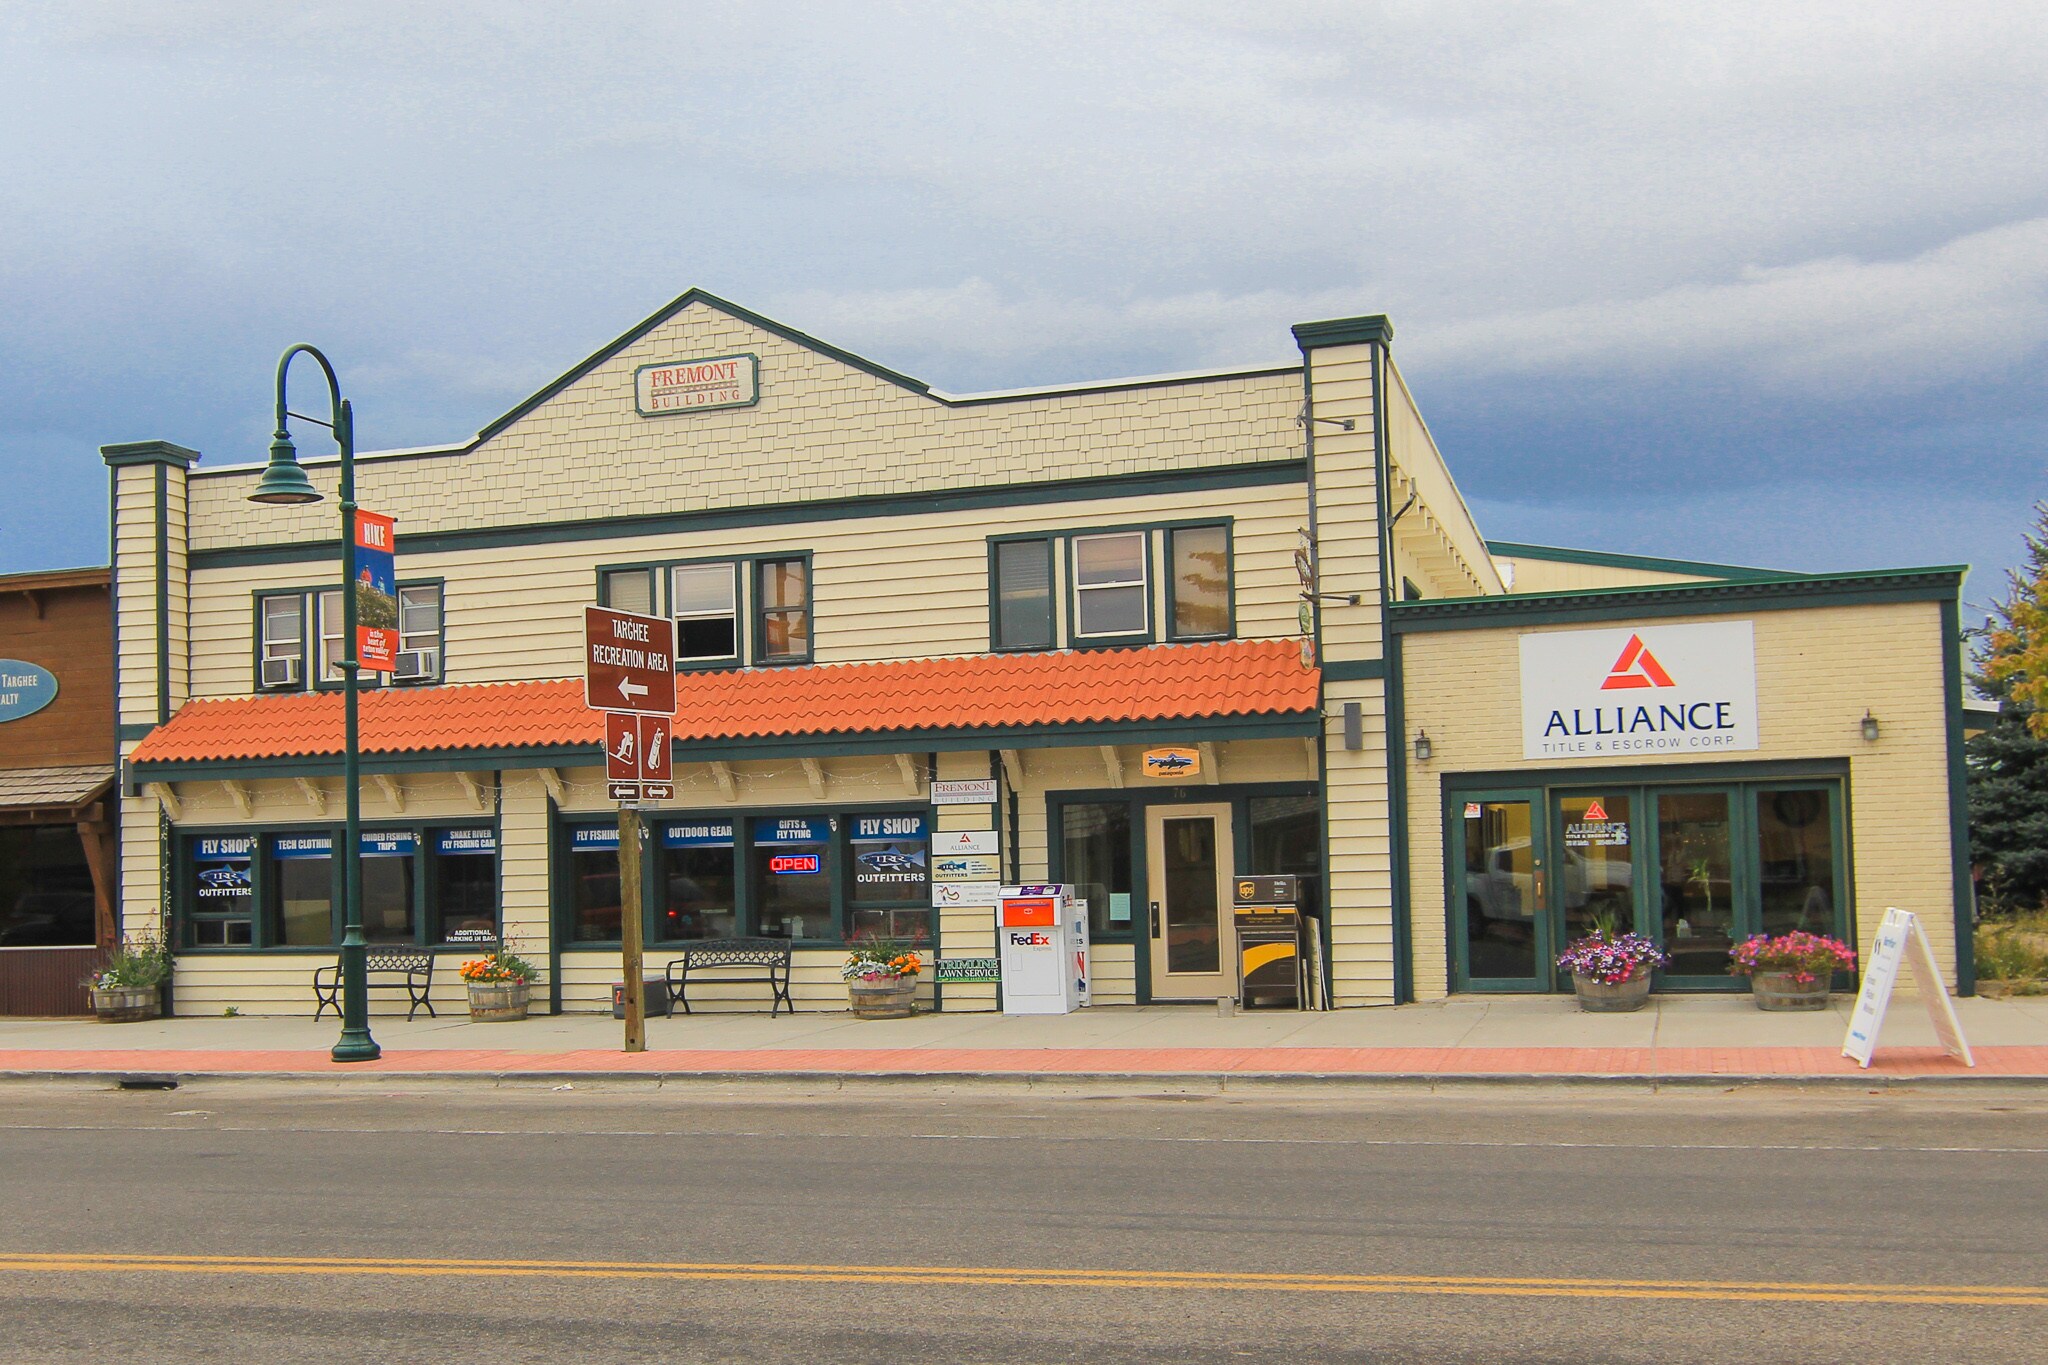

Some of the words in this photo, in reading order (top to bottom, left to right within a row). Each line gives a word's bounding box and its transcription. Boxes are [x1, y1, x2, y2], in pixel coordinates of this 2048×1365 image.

[651, 362, 738, 387] FREMONT
[652, 389, 740, 409] BUILDING
[363, 522, 386, 546] HIKE
[612, 619, 650, 642] TARGHEE
[593, 644, 645, 669] RECREATION
[647, 652, 668, 672] AREA
[1, 674, 38, 687] TARGHEE
[0, 693, 19, 705] ALTY
[1543, 702, 1735, 737] ALLIANCE
[1543, 742, 1586, 752] TITLE
[1595, 741, 1602, 750] &
[1612, 738, 1681, 750] ESCROW
[1690, 735, 1736, 747] CORP.
[935, 782, 993, 792] FREMONT
[1173, 787, 1186, 799] 76
[779, 820, 800, 830] GIFTS
[801, 820, 807, 829] &
[860, 819, 882, 835] FLY
[883, 818, 920, 834] SHOP
[1566, 823, 1626, 834] ALLIANCE
[361, 833, 385, 842] GUIDED
[387, 832, 412, 841] FISHING
[450, 830, 471, 839] SNAKE
[472, 830, 492, 838] RIVER
[576, 830, 589, 841] FLY
[589, 829, 620, 841] FISHING
[668, 827, 709, 838] OUTDOOR
[710, 826, 733, 837] GEAR
[776, 830, 790, 840] FLY
[789, 829, 812, 839] TYING
[202, 839, 219, 854] FLY
[220, 839, 250, 853] SHOP
[278, 840, 297, 850] TECH
[377, 842, 397, 851] TRIPS
[442, 840, 452, 849] FLY
[453, 840, 480, 849] FISHING
[770, 858, 817, 871] OPEN
[857, 873, 926, 883] OUTFITTERS
[198, 888, 252, 897] OUTFITTERS
[1240, 886, 1254, 897] ups
[1010, 932, 1050, 946] FedEx
[938, 959, 999, 970] TRIMLINE
[938, 969, 963, 978] LAWN
[964, 969, 999, 977] SERVICE
